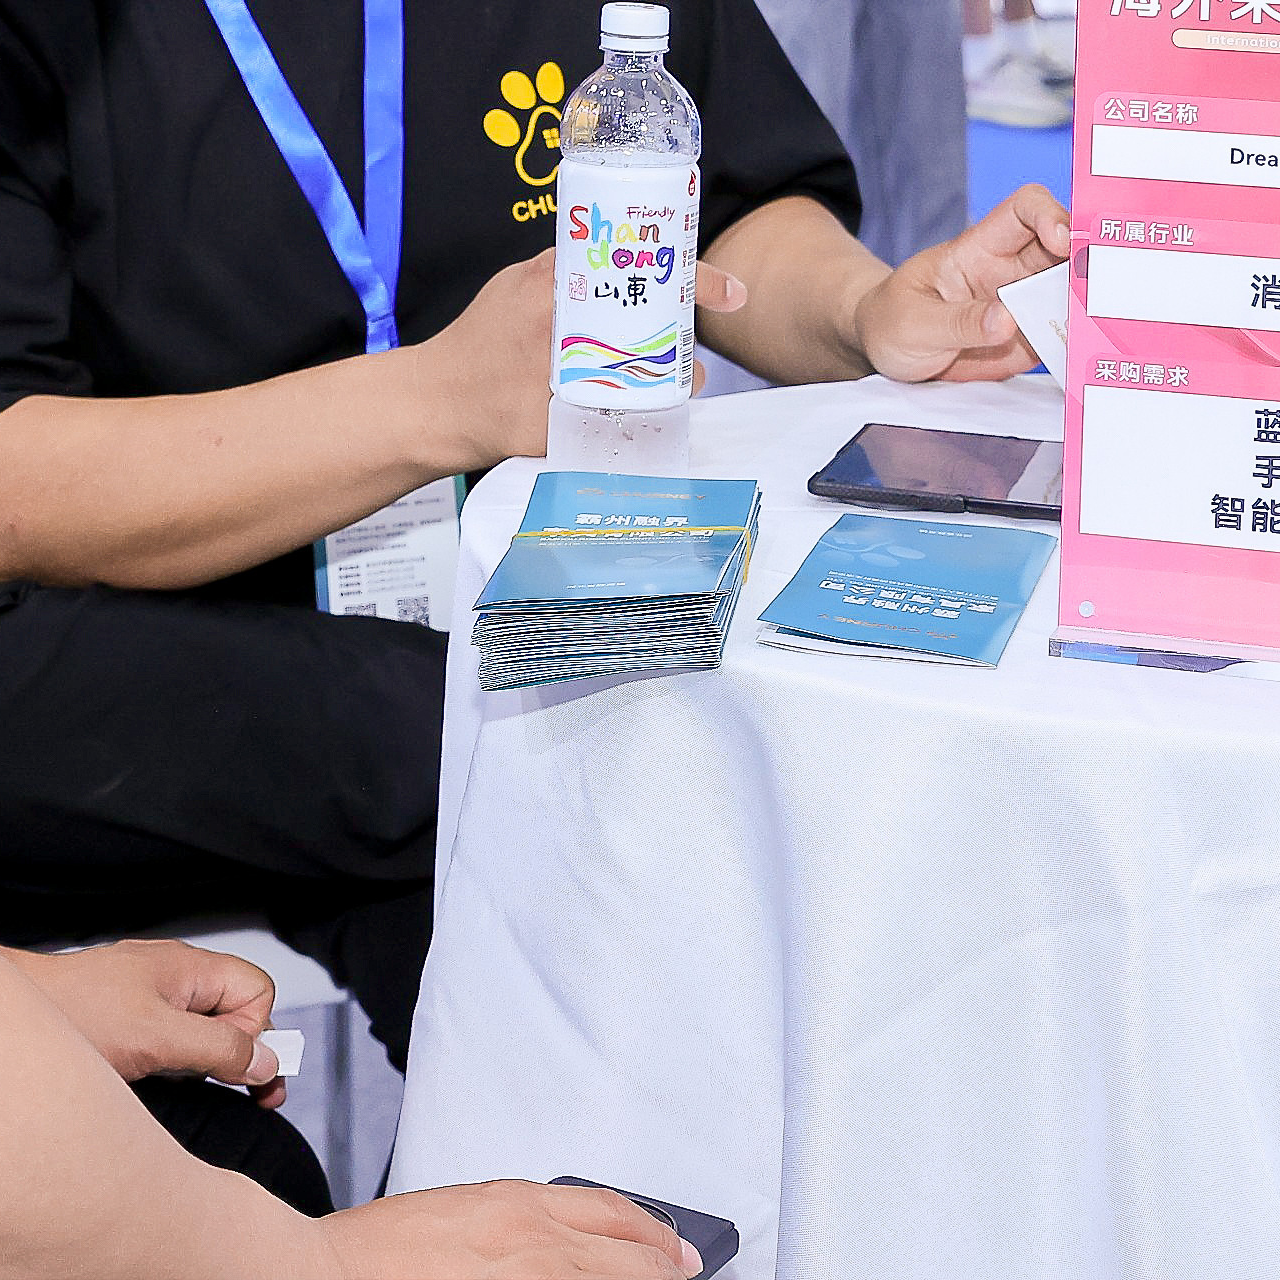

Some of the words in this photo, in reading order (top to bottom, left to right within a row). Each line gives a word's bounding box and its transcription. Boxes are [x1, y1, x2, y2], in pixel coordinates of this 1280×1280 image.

[1103, 97, 1199, 125] 公司名称
[569, 202, 661, 244] Shan
[626, 205, 676, 221] Friendly
[1099, 219, 1195, 247] 所属行业
[586, 239, 675, 285] dong
[1094, 360, 1190, 387] 采购需求
